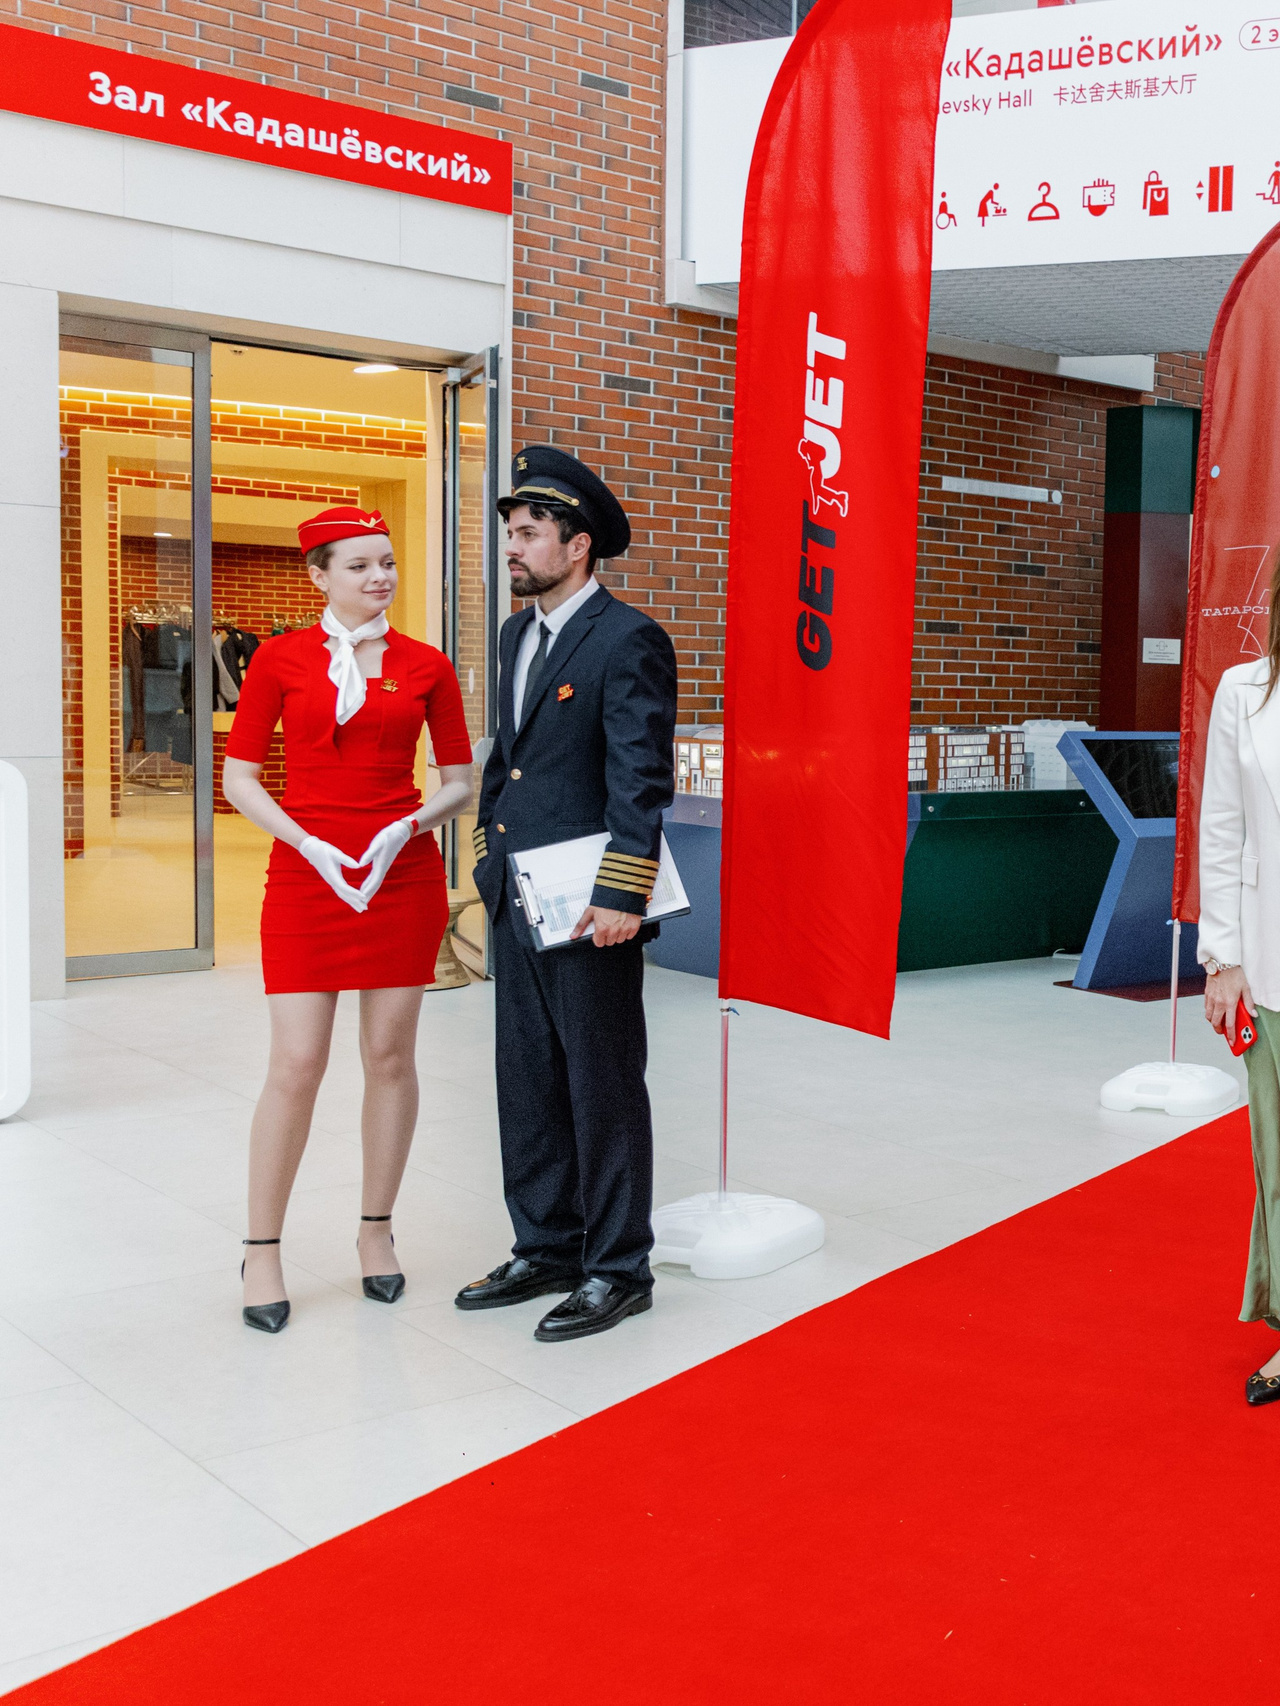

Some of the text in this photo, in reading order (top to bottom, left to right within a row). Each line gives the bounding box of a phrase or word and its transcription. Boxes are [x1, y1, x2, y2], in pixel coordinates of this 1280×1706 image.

[945, 24, 1222, 80] «Кадашёвский»
[1251, 25, 1261, 44] 2
[938, 89, 1032, 115] evsky Hall
[1053, 73, 1197, 106] 卡达舍夫斯基大厅
[88, 71, 491, 185] Зал «Кадашёвский»
[797, 311, 846, 671] GET JET
